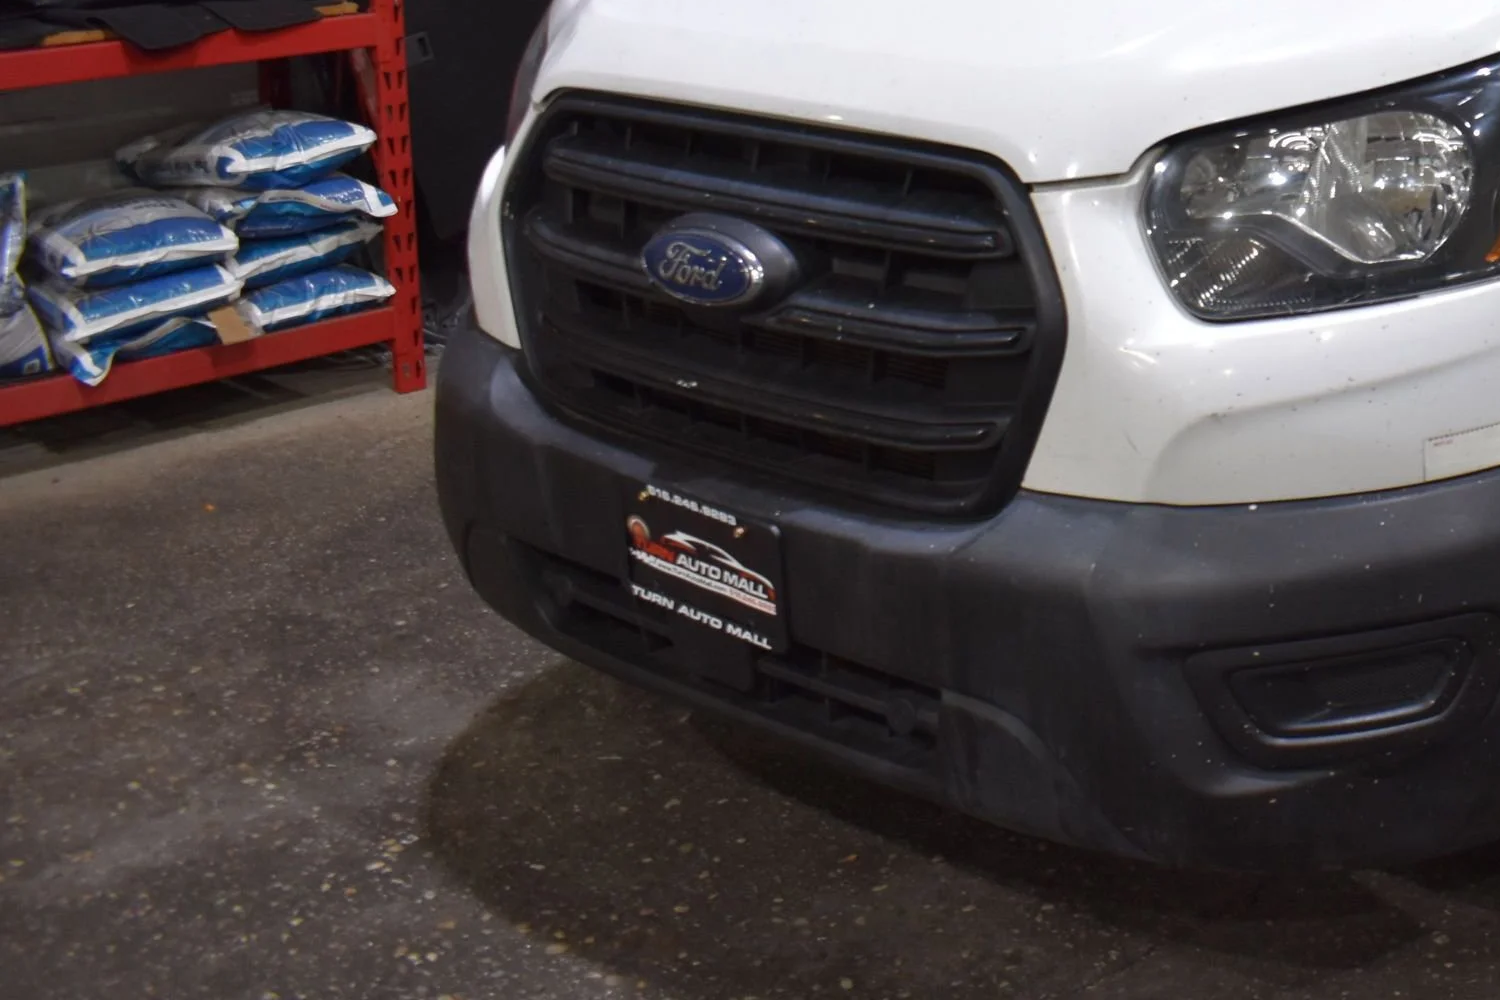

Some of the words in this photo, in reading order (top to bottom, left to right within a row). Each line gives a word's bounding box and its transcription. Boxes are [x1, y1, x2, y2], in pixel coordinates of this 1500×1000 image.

[658, 241, 728, 291] Ford
[676, 554, 721, 580] AUTO
[723, 571, 768, 599] MALL
[632, 585, 675, 610] TURN
[678, 605, 723, 630] AUTO
[726, 624, 772, 650] MALL
